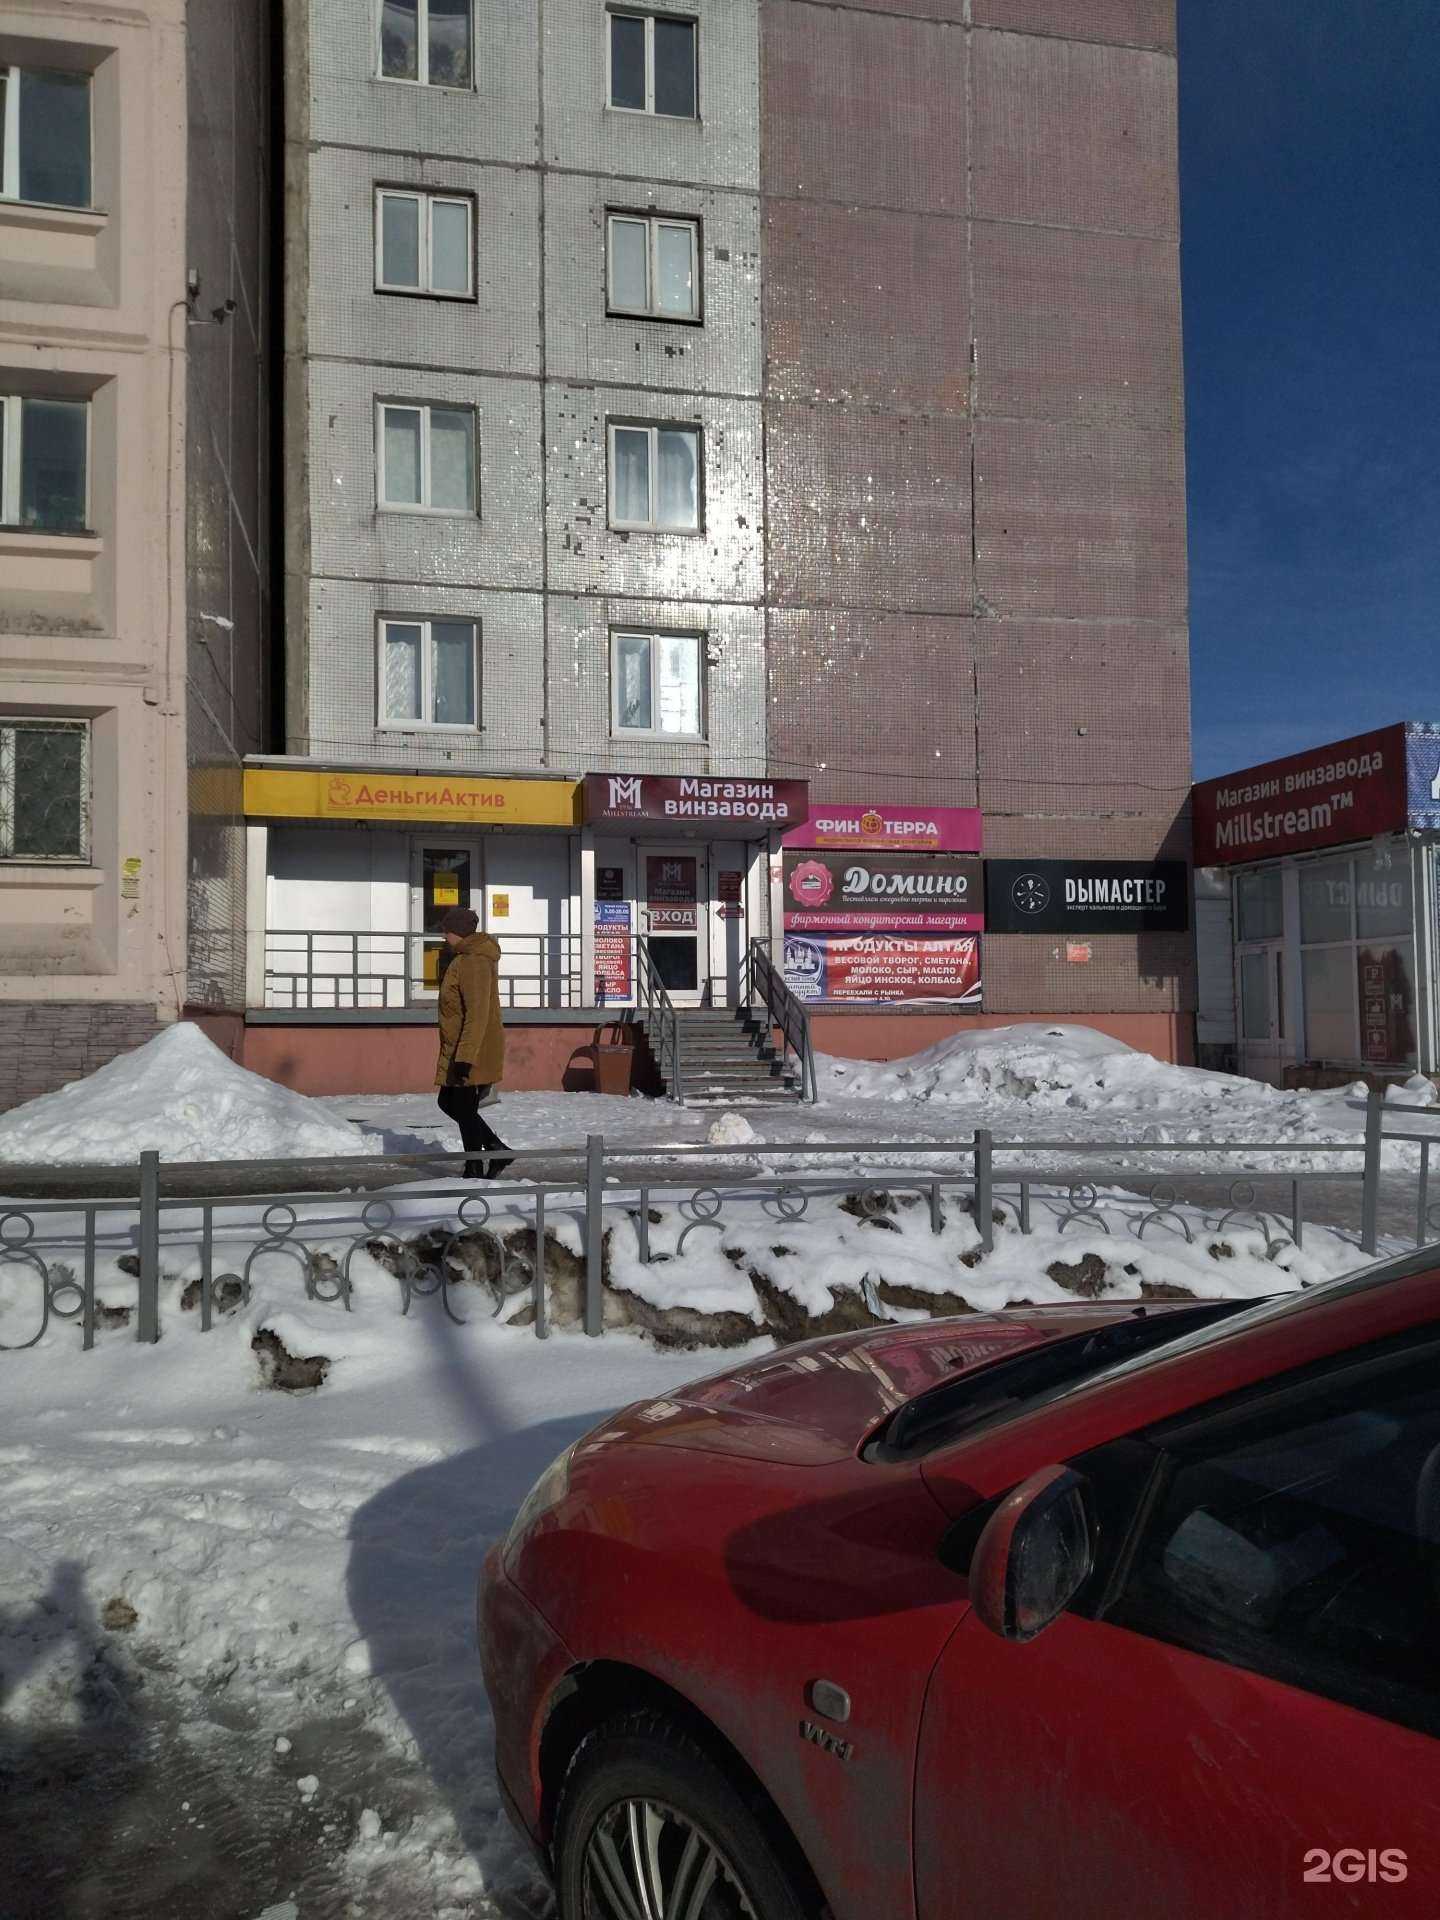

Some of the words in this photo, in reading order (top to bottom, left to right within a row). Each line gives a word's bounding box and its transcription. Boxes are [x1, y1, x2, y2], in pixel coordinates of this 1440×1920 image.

[1216, 777, 1280, 810] Магазин
[1284, 751, 1383, 793] винзавода
[355, 785, 505, 808] ДеньгиАктив
[680, 779, 773, 799] Магазин
[664, 800, 788, 820] винзавода
[816, 820, 860, 833] ФИН
[883, 821, 938, 835] ТЕРРА
[842, 867, 968, 896] Домино
[652, 911, 693, 924] ВХОД
[791, 913, 850, 928] фирменный
[853, 914, 923, 928] кондитерский
[926, 916, 968, 929] магазин
[832, 940, 918, 953] ПРОДУКТЫ
[834, 956, 880, 964] ВЕСОВОЙ
[883, 957, 922, 965] ТВОРОГ,
[924, 957, 972, 966] СМЕТАНА,
[850, 967, 894, 975] МОЛОКО,
[897, 967, 921, 975] СЫР,
[923, 967, 956, 975] МАСЛО
[845, 975, 872, 985] ЯЙЦО
[874, 976, 916, 985] ИНСКОЕ,
[918, 977, 963, 985] КОЛБАСА
